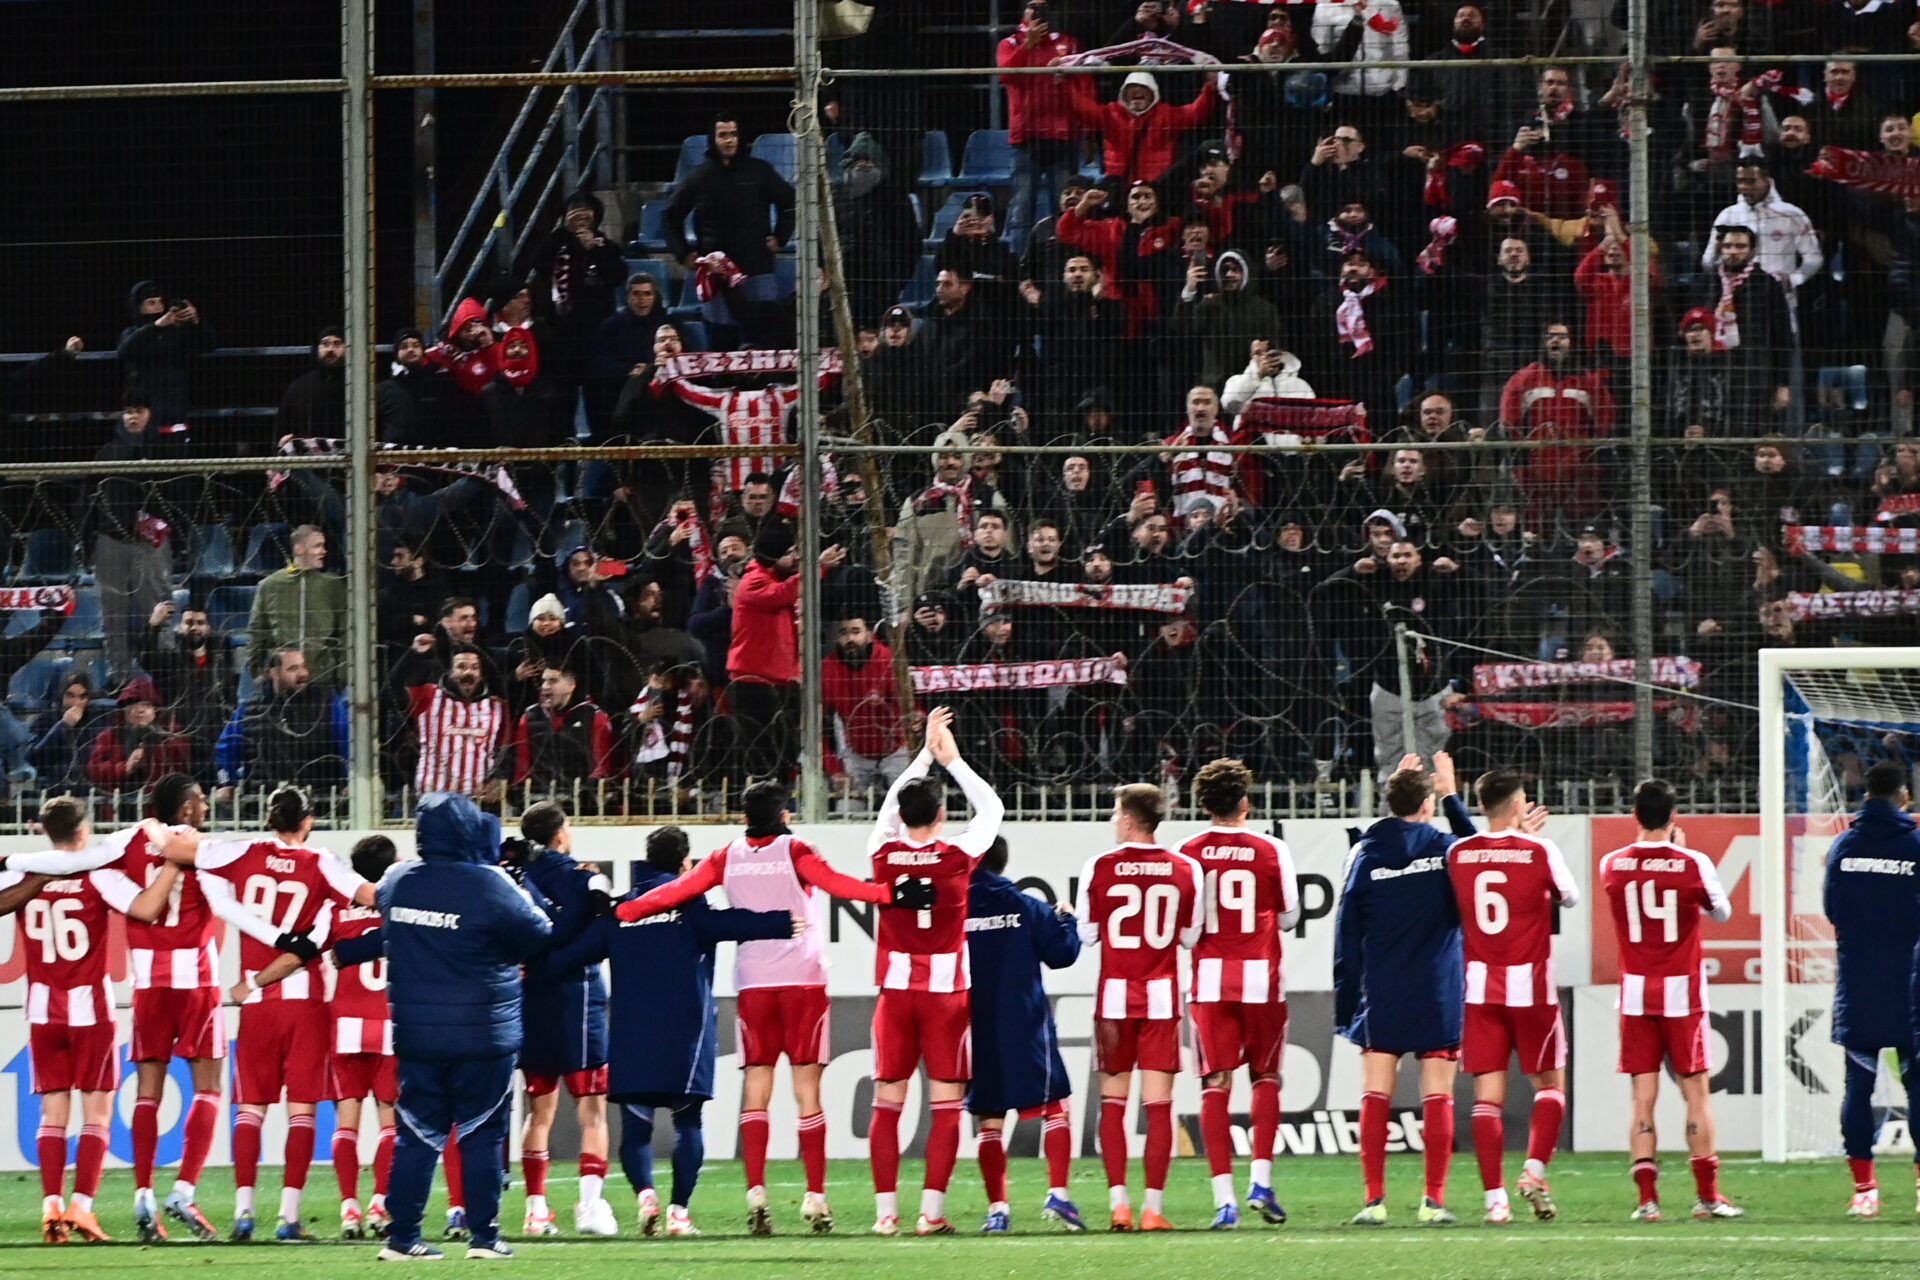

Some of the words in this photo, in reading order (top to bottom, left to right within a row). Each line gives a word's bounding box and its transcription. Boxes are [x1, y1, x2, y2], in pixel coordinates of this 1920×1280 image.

[1202, 846, 1255, 862] CLAYTON
[1115, 862, 1173, 876] COSTINHA
[1641, 858, 1686, 872] GARCIA
[1840, 858, 1900, 875] OLYMPIACOS
[1900, 861, 1916, 876] FC
[1206, 869, 1257, 934] 19
[1474, 870, 1509, 935] 6
[1106, 884, 1181, 949] 20
[1624, 879, 1678, 943] 14
[444, 913, 461, 930] FC
[1006, 913, 1022, 929] FC
[24, 898, 90, 963] 96
